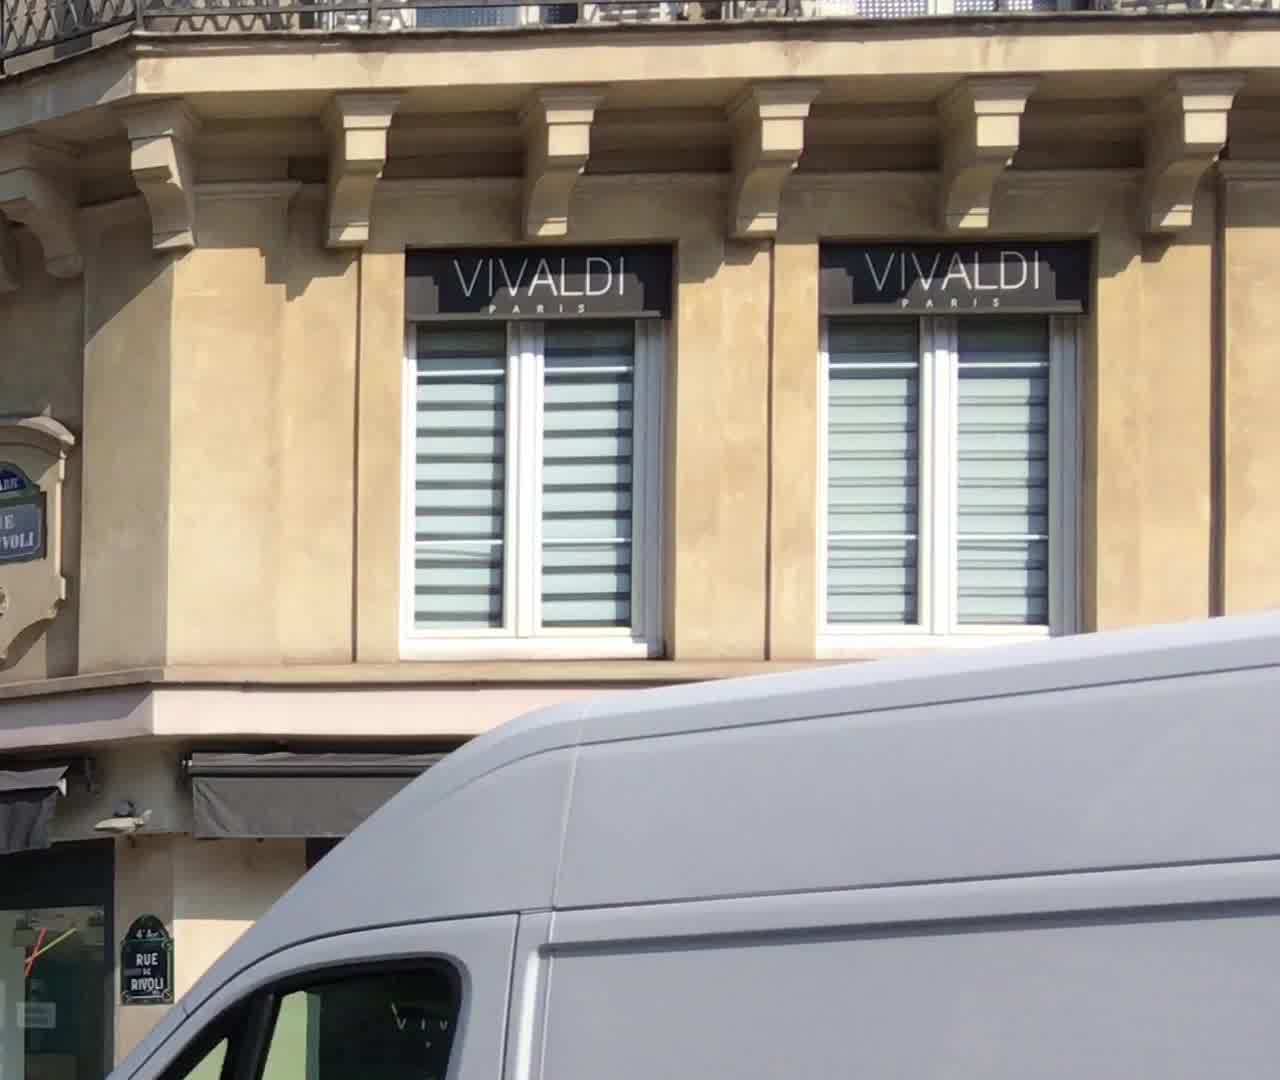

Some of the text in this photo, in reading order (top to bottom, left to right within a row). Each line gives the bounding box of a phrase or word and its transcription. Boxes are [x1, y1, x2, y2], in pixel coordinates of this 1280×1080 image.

[453, 256, 624, 296] VIVALDI
[865, 250, 1039, 292] VIVALDI
[489, 303, 585, 314] PARIS
[902, 298, 1000, 308] PARIS
[136, 952, 159, 967] RUE
[131, 977, 164, 991] RIVOLI
